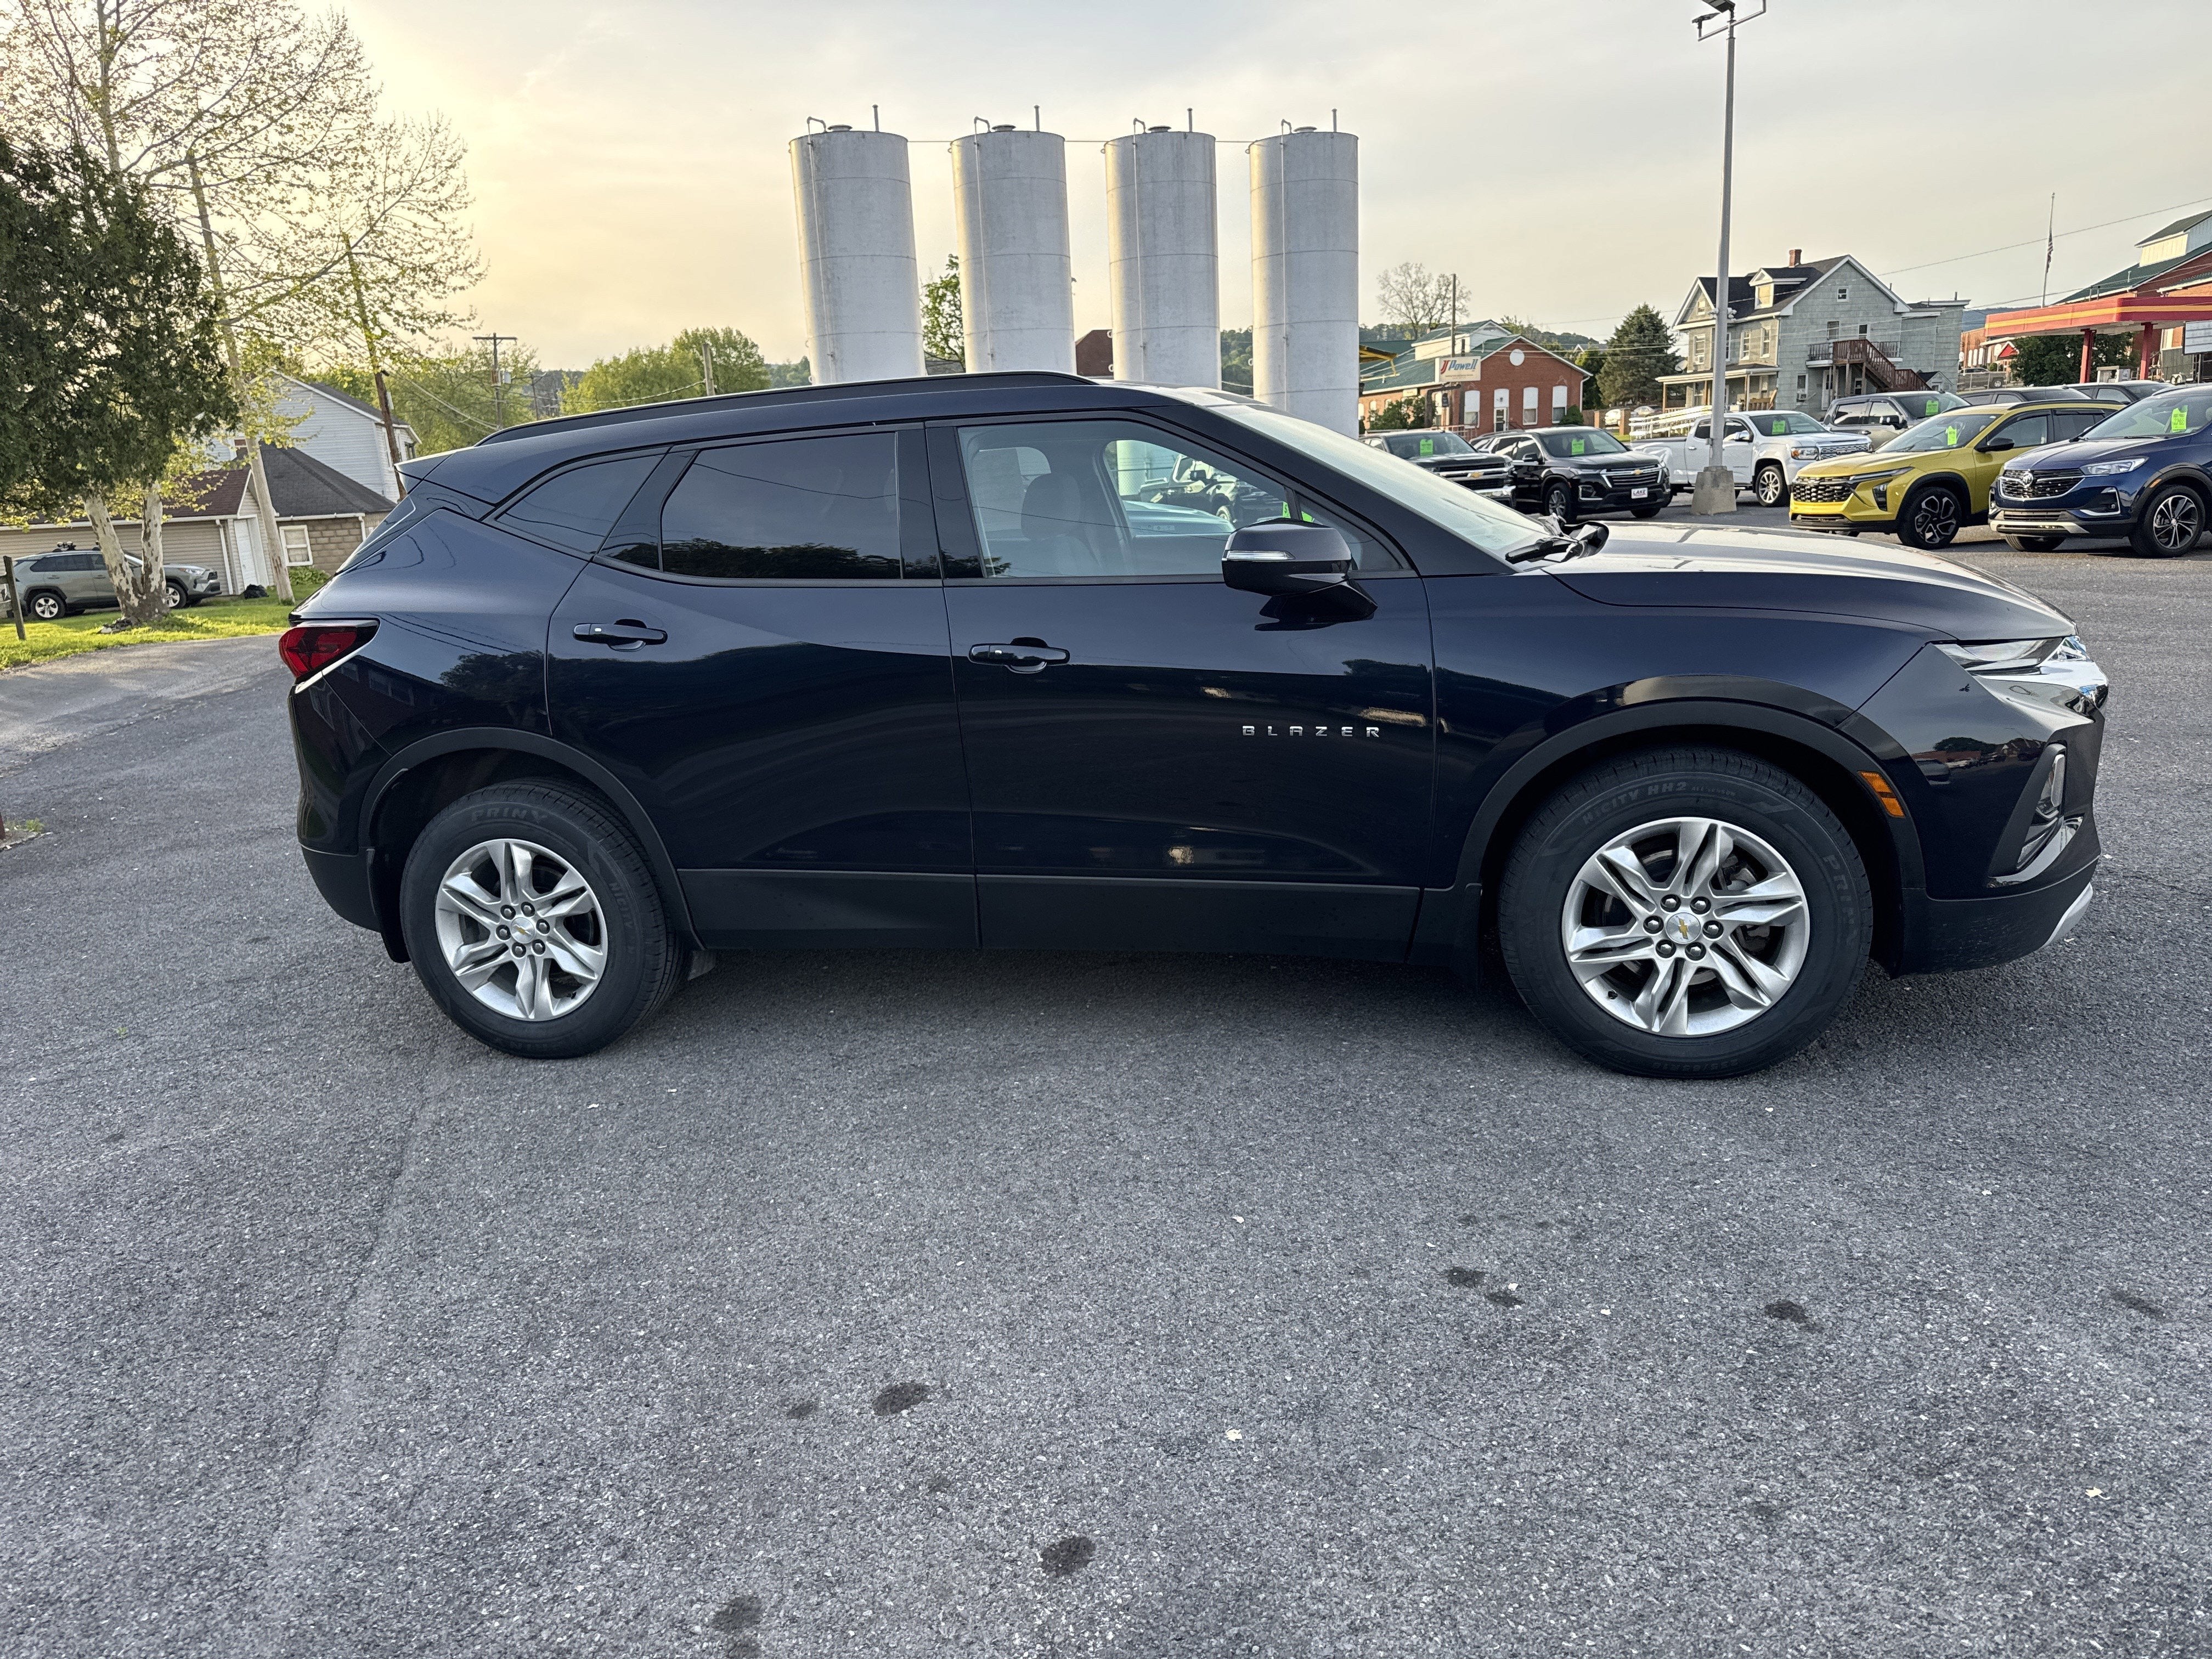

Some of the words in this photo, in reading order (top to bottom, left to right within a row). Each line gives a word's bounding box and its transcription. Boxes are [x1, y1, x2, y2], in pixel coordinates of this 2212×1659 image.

[1448, 359, 1479, 371] Powell
[1242, 726, 1380, 738] BLAZER
[1647, 781, 1688, 796] HH2
